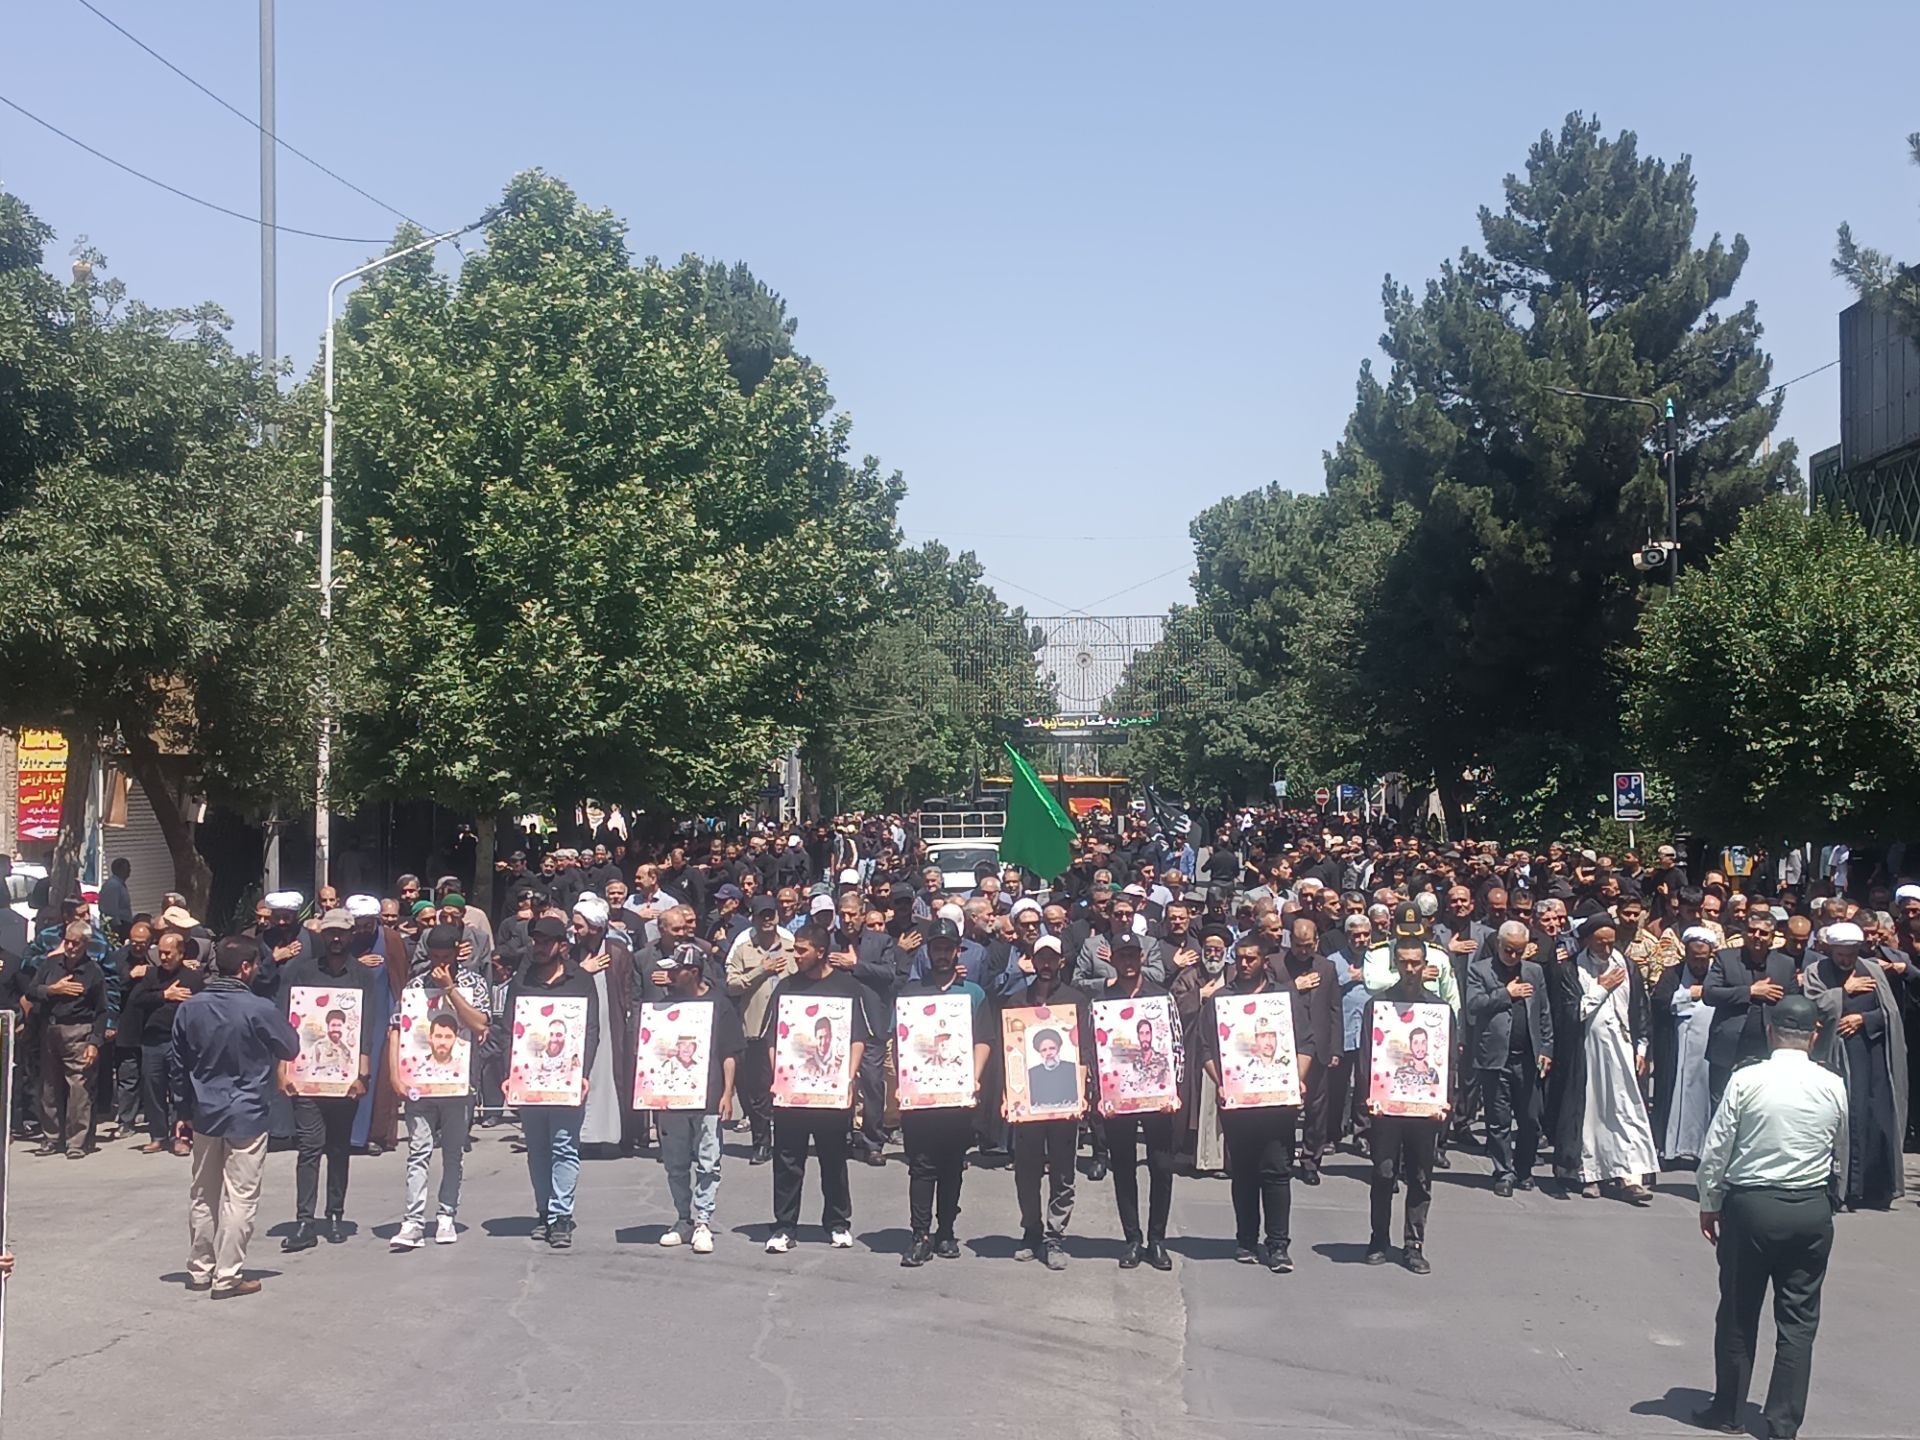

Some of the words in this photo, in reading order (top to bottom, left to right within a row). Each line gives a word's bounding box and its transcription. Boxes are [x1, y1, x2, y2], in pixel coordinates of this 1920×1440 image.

[1086, 714, 1106, 726] شما
[1107, 716, 1120, 728] به
[1631, 776, 1640, 789] P
